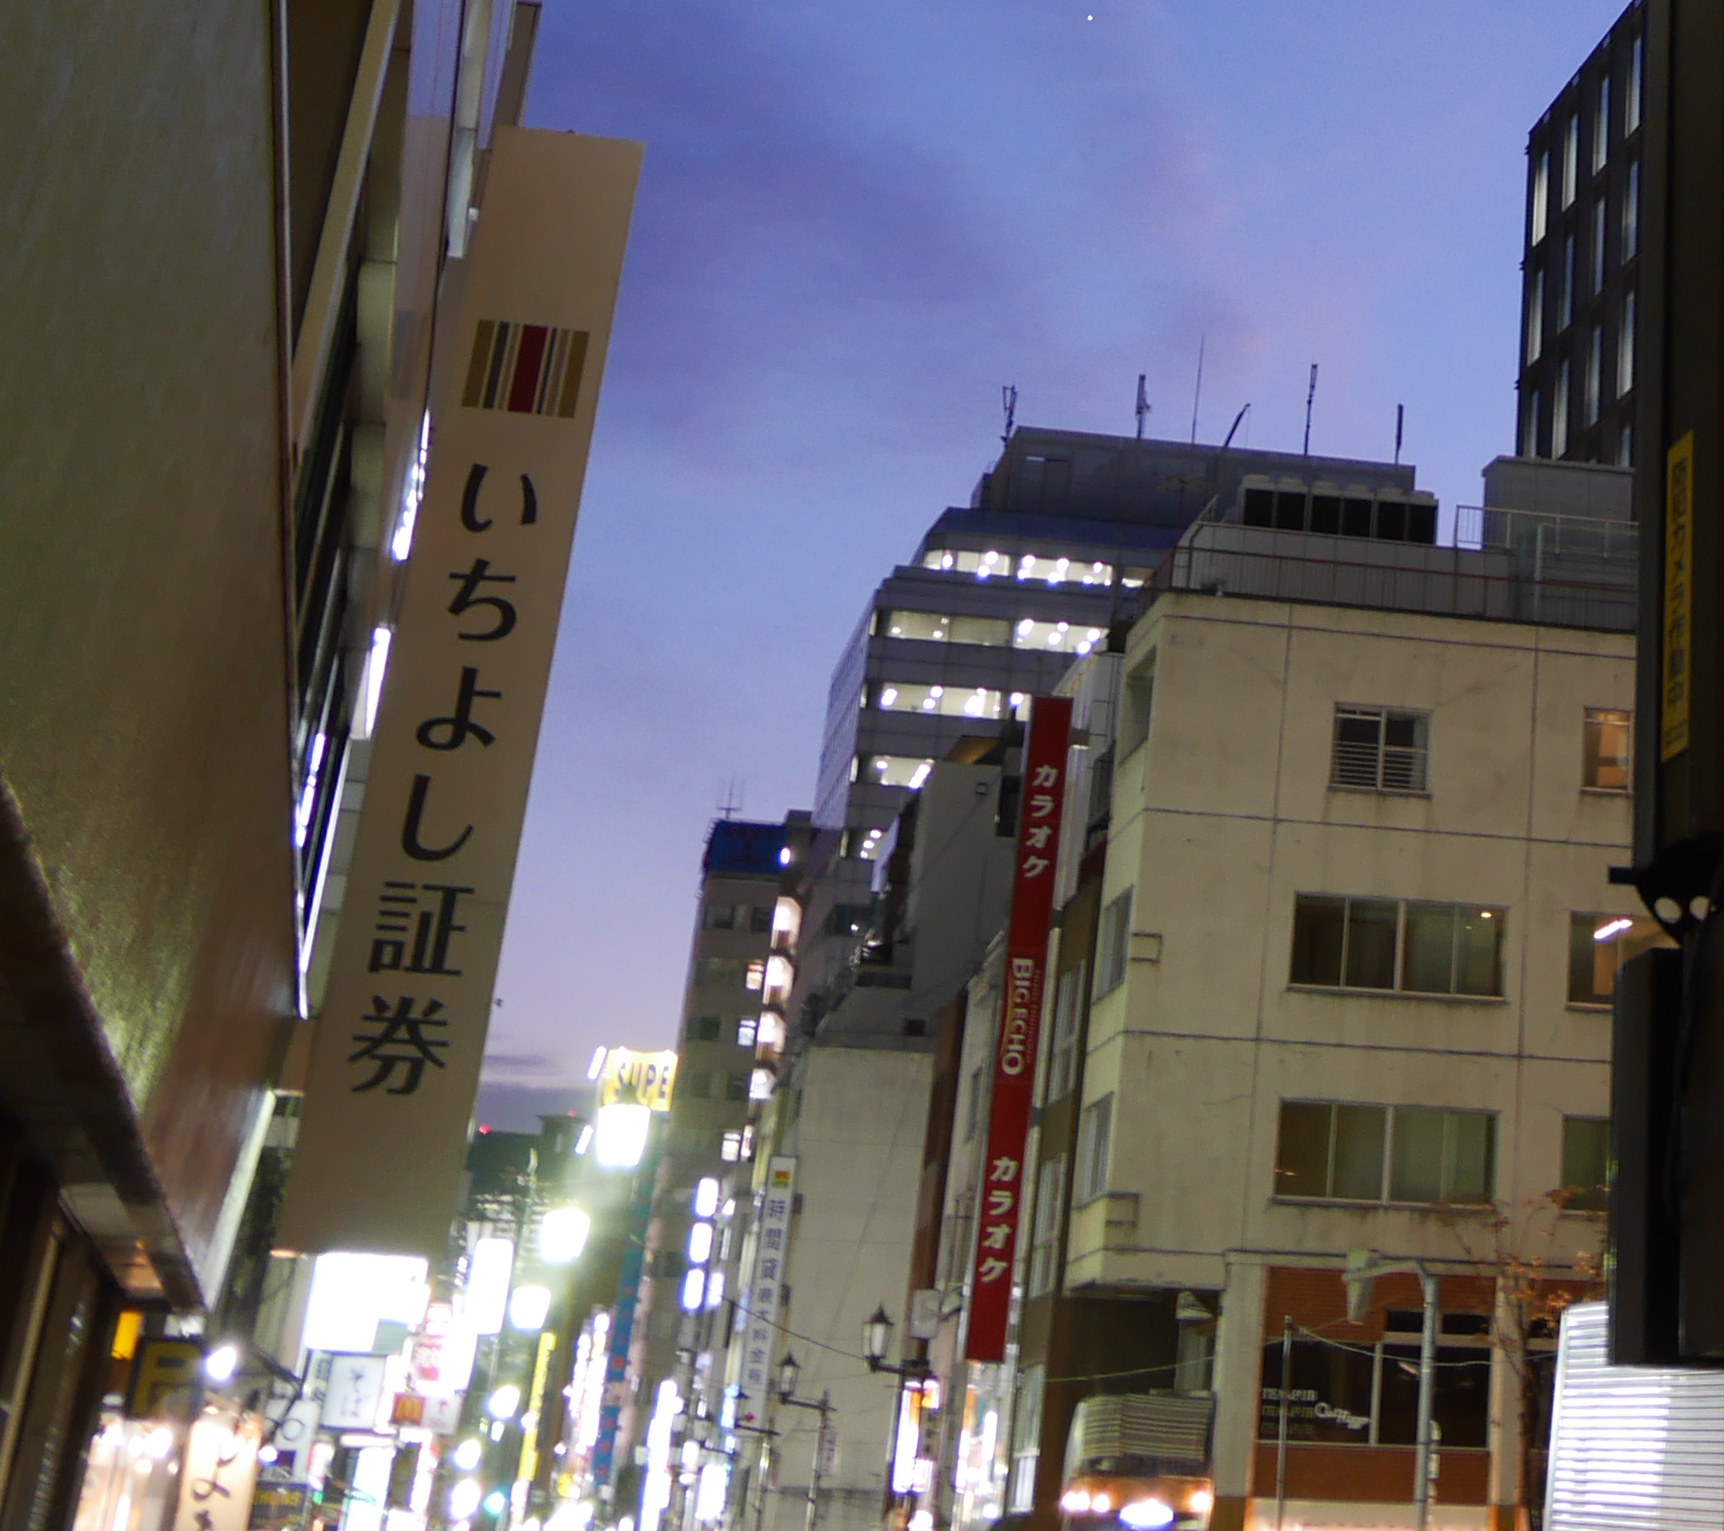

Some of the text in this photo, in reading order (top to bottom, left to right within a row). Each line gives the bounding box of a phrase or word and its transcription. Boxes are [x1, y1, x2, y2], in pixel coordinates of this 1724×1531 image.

[348, 462, 539, 1098] いちよし証券
[1022, 763, 1059, 879] カラオケ
[1011, 957, 1035, 1004] BIG
[1002, 1007, 1029, 1075] ECHO
[978, 1155, 1020, 1283] カラオケ
